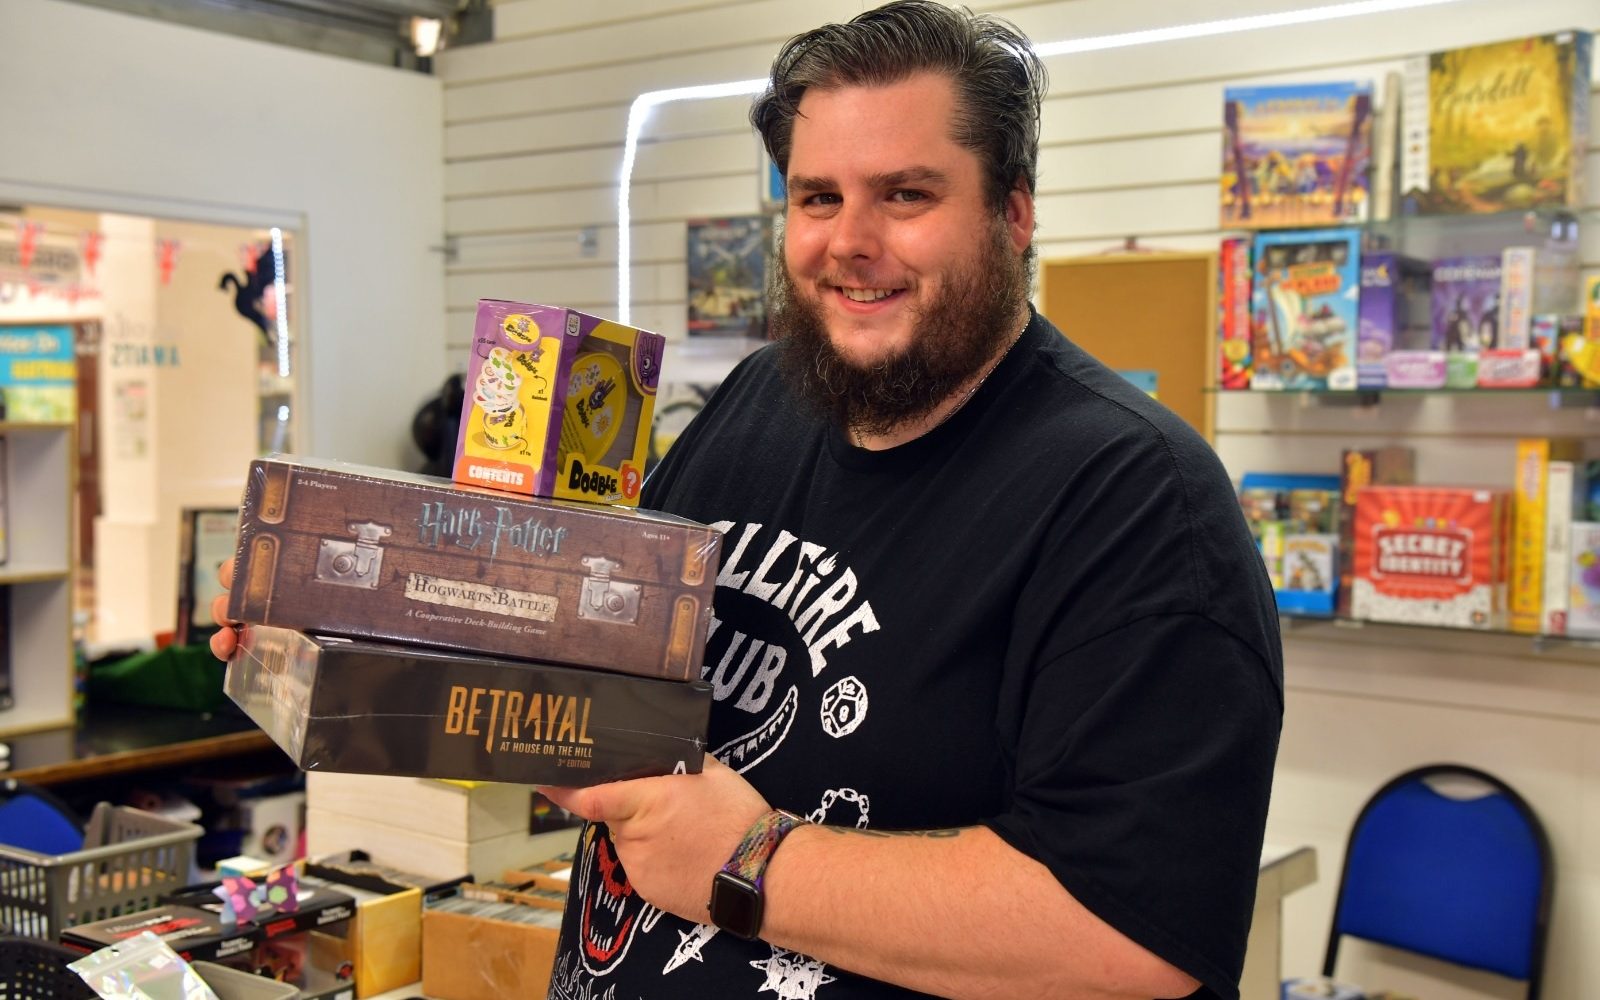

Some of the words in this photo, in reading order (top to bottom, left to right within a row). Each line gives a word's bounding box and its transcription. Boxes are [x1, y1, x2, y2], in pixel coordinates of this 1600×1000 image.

[297, 478, 309, 486] 2-4
[310, 480, 338, 490] Players
[468, 464, 525, 486] CONTENTS
[568, 459, 618, 496] DOBBLE
[415, 502, 483, 550] Harry
[489, 506, 569, 567] Potter
[641, 531, 658, 541] Ages
[1379, 533, 1465, 559] SECRET
[1380, 555, 1463, 577] IDENTITY
[414, 577, 493, 603] HOGWARTS
[498, 592, 551, 613] BATTLE
[708, 520, 881, 678] LLFIRE
[405, 609, 413, 618] A
[414, 610, 463, 624] Cooperative
[464, 616, 522, 633] Deck-Building
[523, 625, 547, 636] Game
[445, 685, 594, 754] BETRAYAL
[500, 741, 511, 752] AT
[513, 742, 541, 754] HOUSE
[543, 744, 555, 756] ON
[558, 745, 572, 757] THE
[575, 747, 593, 758] HILL
[567, 759, 591, 769] EDITION
